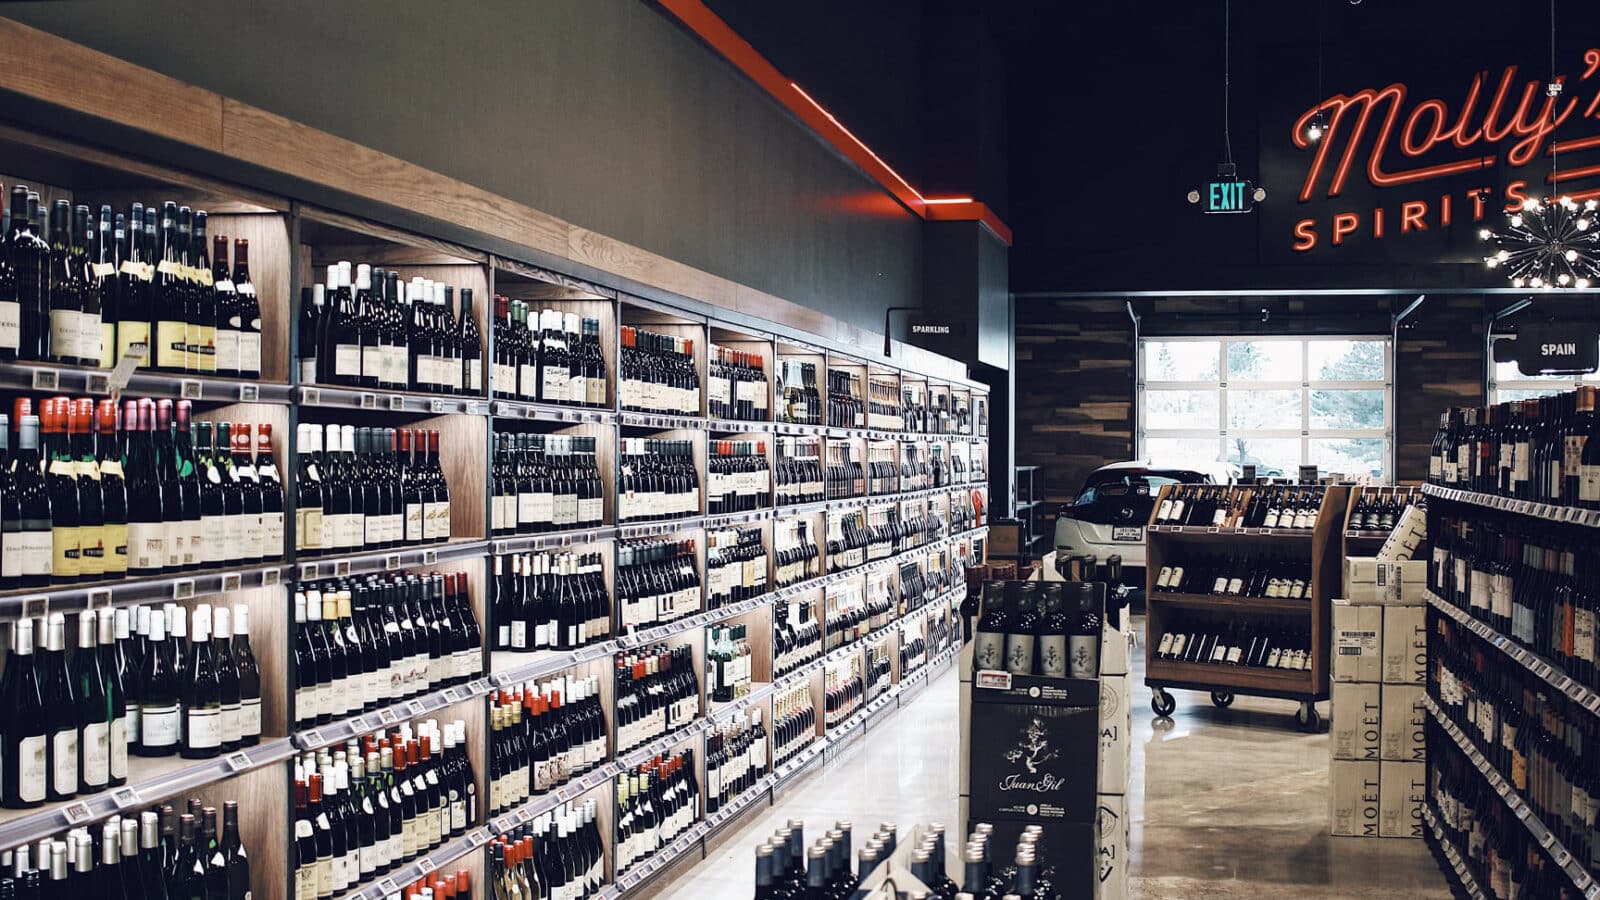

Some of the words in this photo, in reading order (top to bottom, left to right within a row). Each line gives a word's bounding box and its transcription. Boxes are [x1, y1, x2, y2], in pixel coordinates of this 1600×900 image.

[1209, 182, 1246, 210] EXIT
[1292, 180, 1530, 252] SPIRITS
[912, 325, 949, 333] SPARKLING
[1541, 343, 1576, 356] SPAIN
[1363, 702, 1378, 759] MOËT
[999, 774, 1036, 791] Juan
[1036, 773, 1065, 792] Gil
[1362, 779, 1378, 836] MOËT
